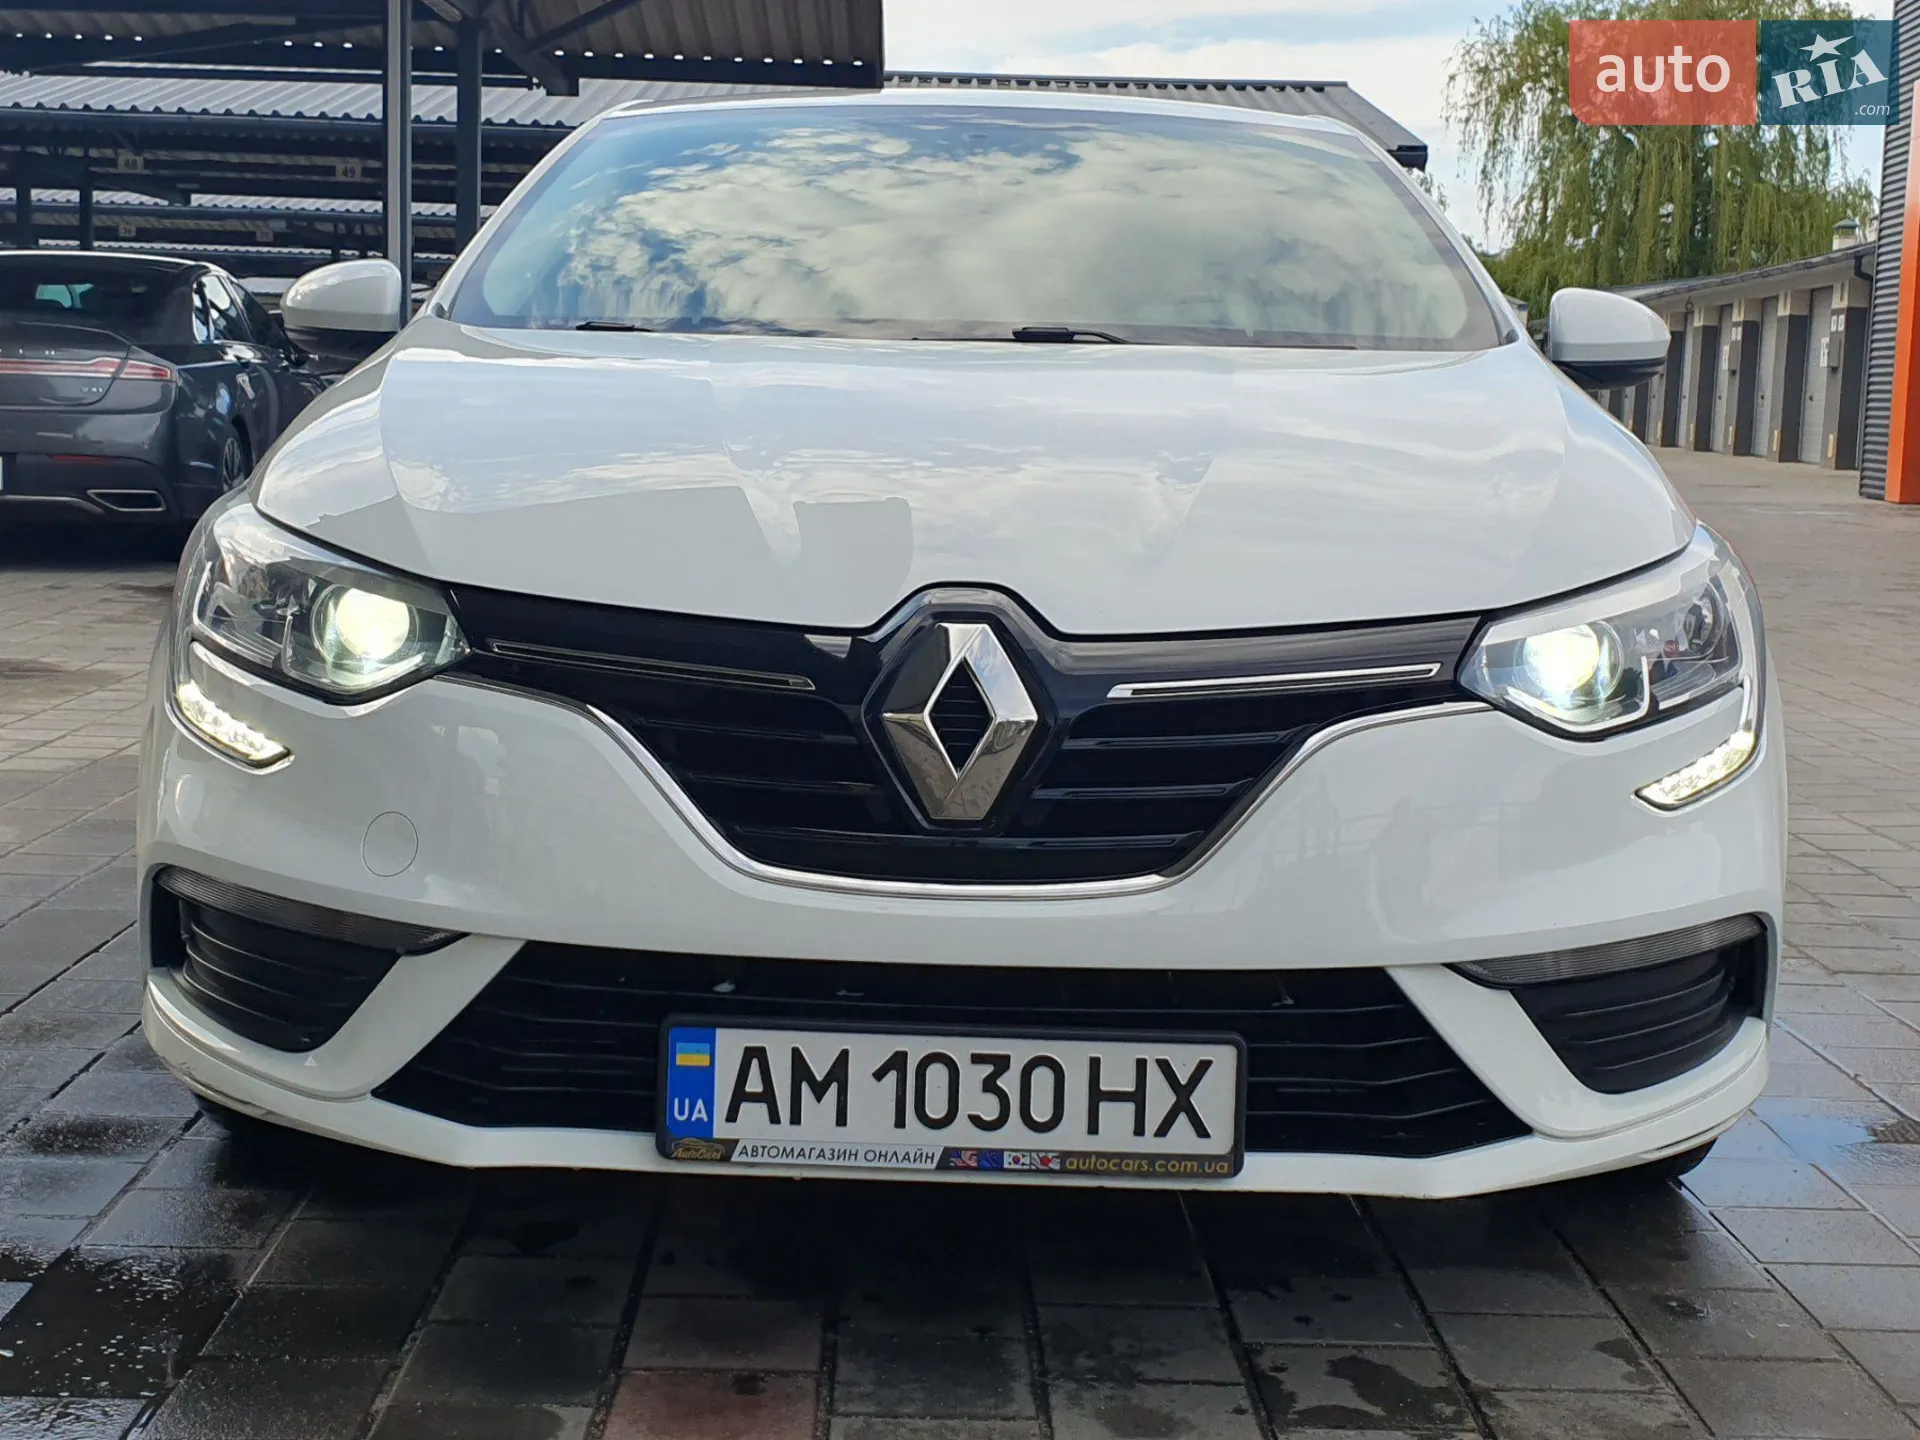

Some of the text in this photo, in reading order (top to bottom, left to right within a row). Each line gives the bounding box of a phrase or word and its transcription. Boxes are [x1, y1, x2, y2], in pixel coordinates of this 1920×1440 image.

[725, 1045, 1213, 1138] AM 1030 HX
[673, 1097, 708, 1122] UA
[738, 1145, 936, 1164] АВТОМАГАЗИН ОНЛАЙН
[1065, 1154, 1229, 1173] autocars.com.ua
